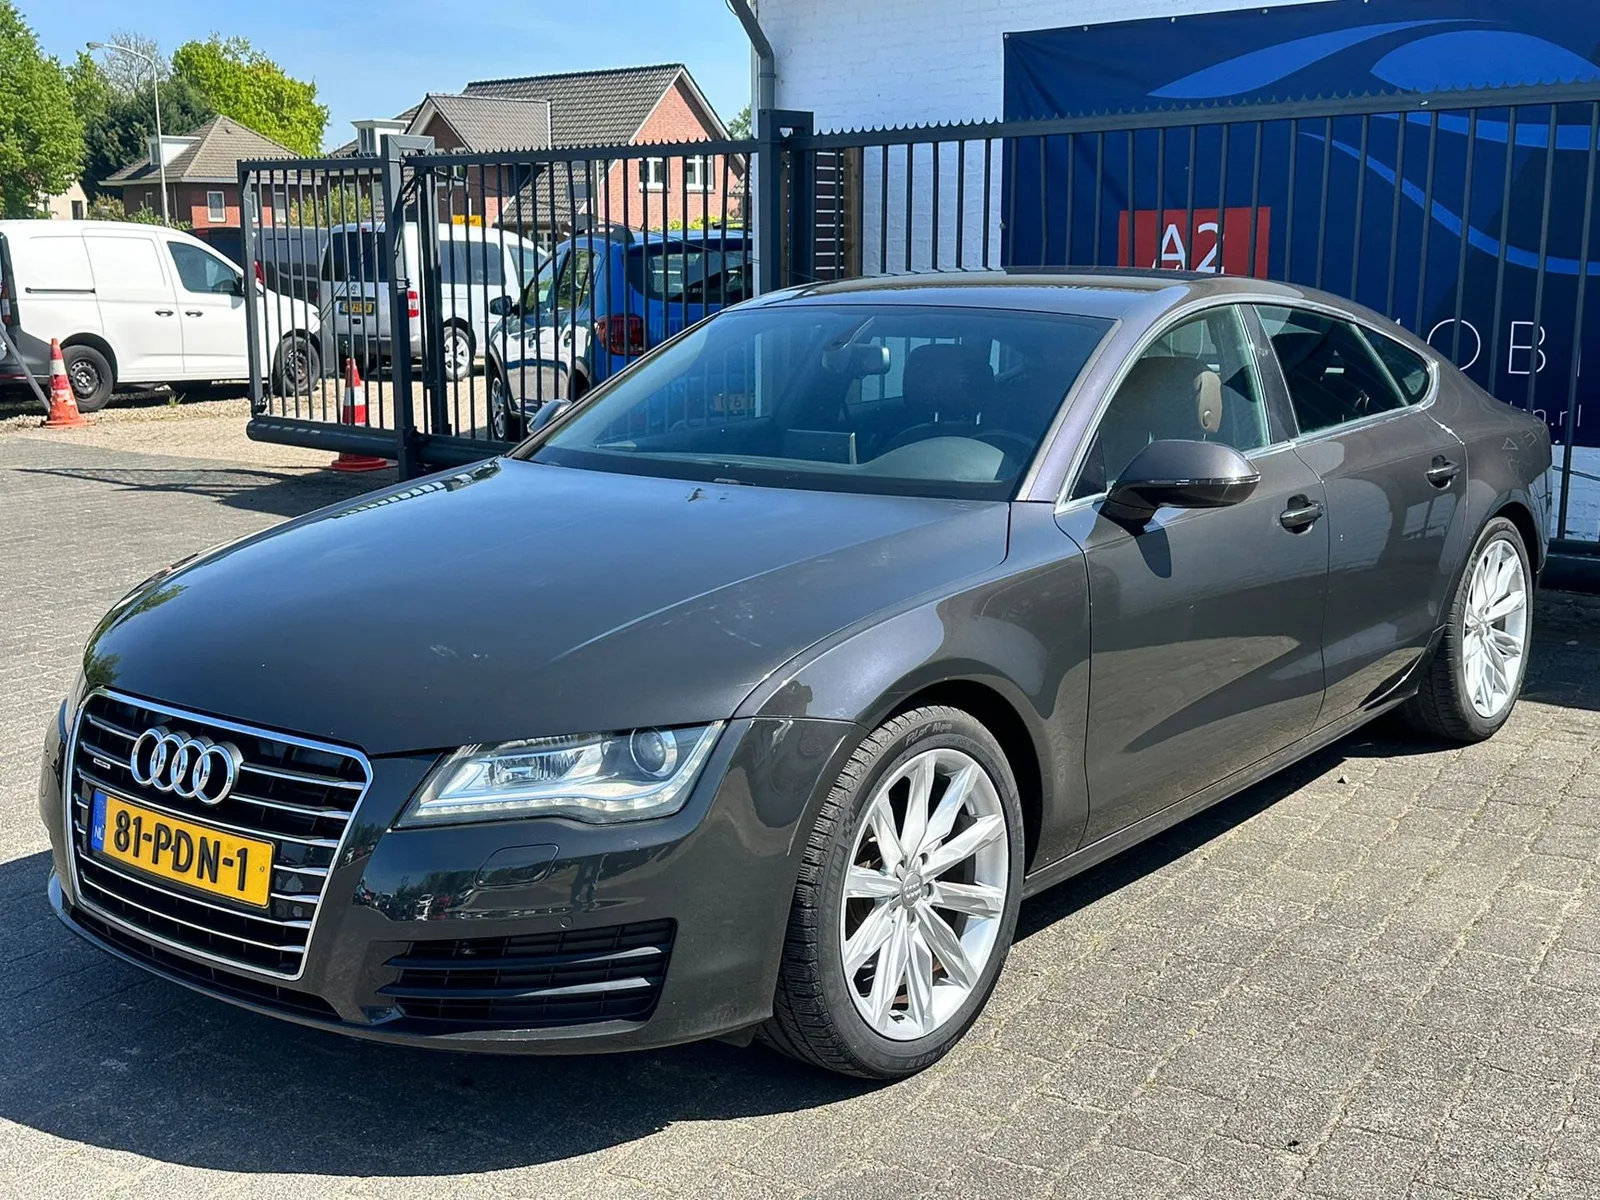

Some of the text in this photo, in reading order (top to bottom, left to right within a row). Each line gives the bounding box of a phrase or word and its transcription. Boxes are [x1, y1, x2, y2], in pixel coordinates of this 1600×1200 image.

[1160, 222, 1225, 274] A2
[94, 825, 103, 841] NL
[113, 810, 248, 892] 81-PDN-1
